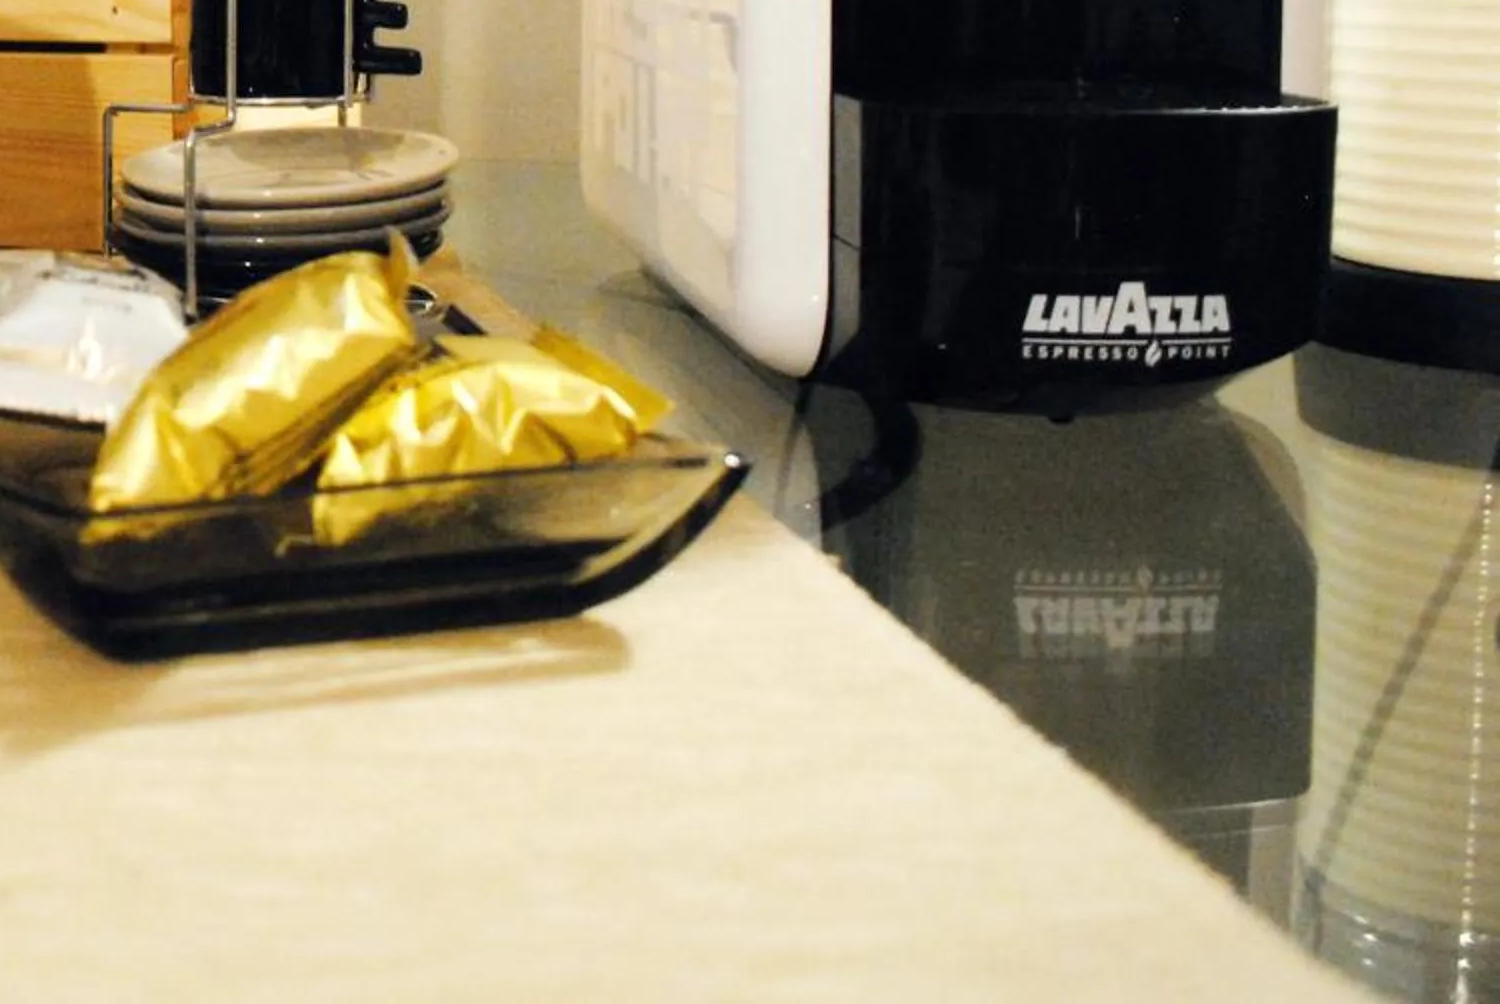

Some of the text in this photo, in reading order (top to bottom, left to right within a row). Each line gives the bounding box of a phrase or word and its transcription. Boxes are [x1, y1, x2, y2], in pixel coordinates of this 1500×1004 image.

[1022, 281, 1231, 334] LAVAZZA
[1022, 345, 1231, 360] ESPRESSO POINT
